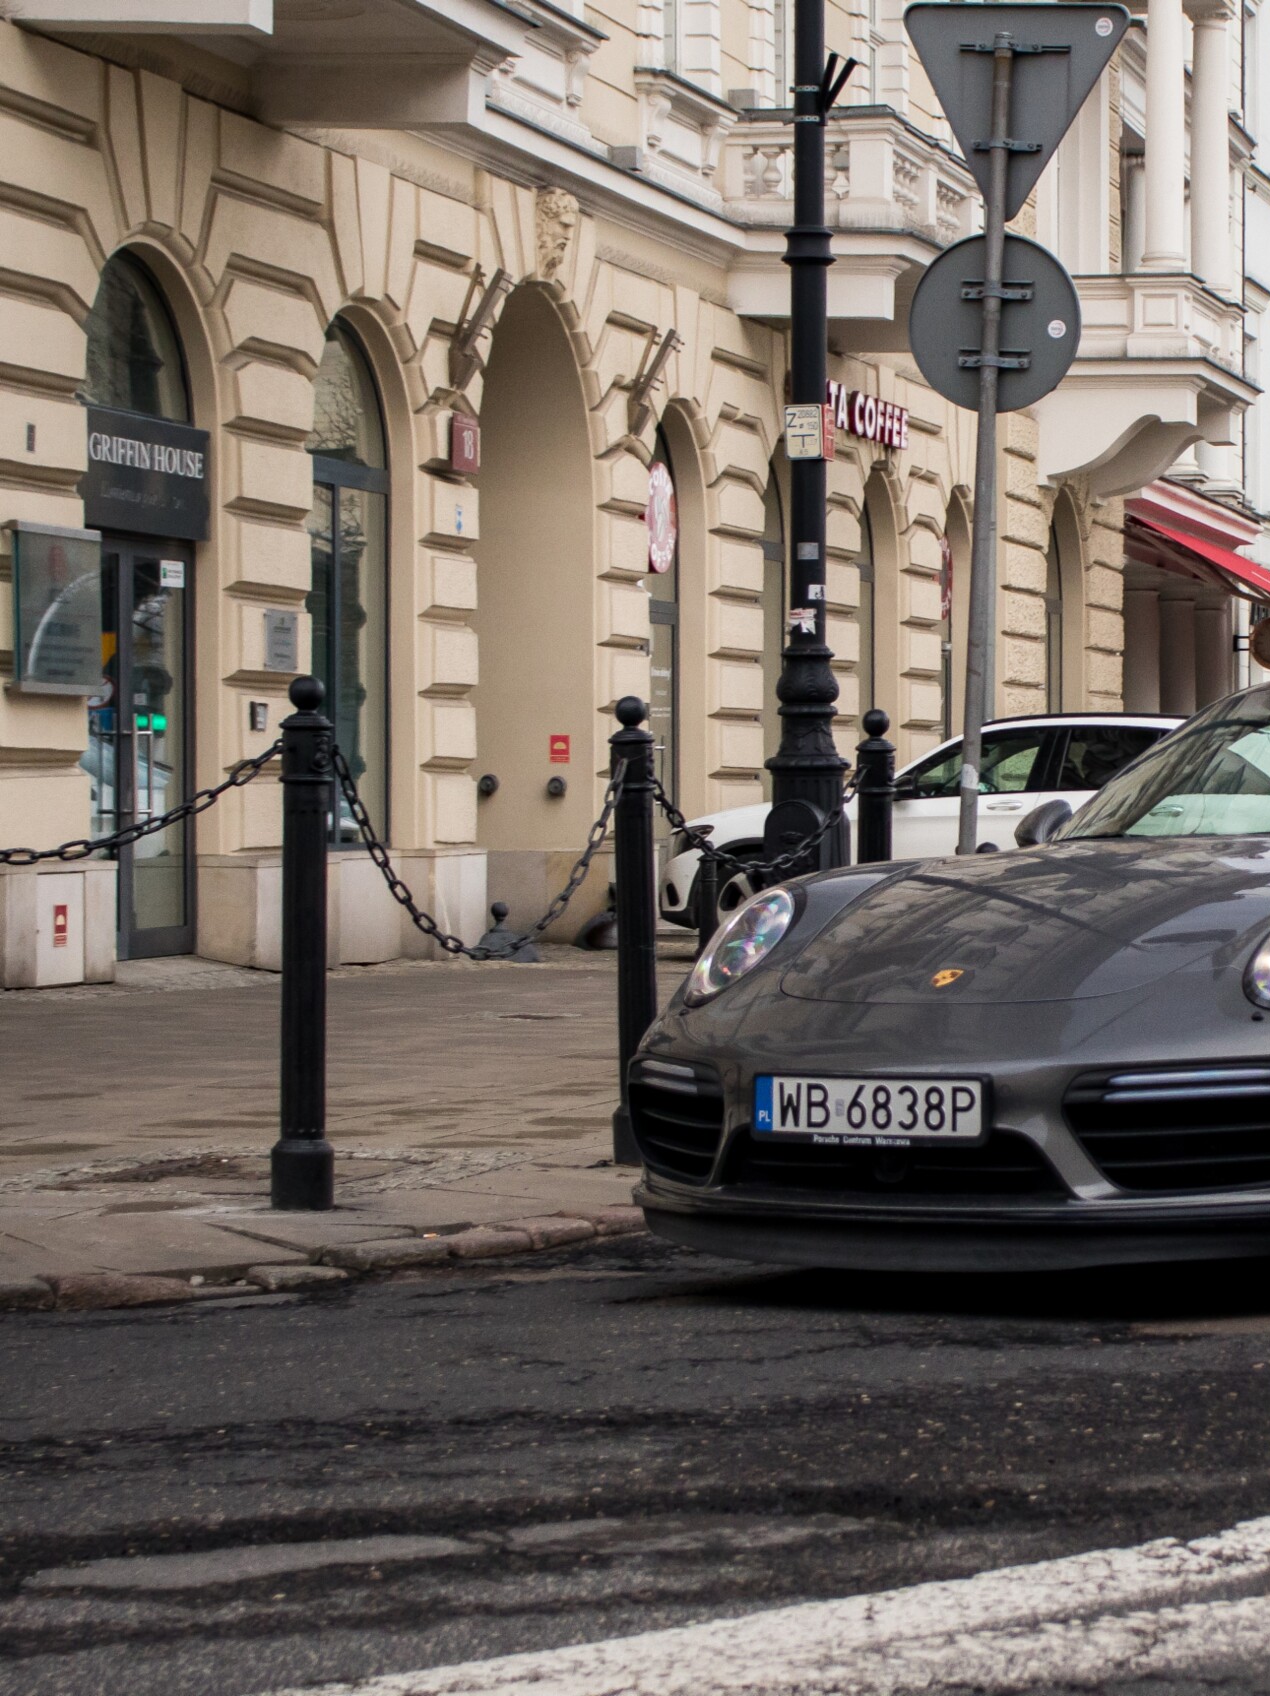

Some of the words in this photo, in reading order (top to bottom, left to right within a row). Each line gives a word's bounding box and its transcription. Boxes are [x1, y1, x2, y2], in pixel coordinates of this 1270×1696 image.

[786, 412, 798, 428] Z
[852, 391, 908, 449] COFFEE
[89, 432, 151, 470] GRIFFIN
[153, 444, 204, 479] HOUSE
[462, 430, 474, 460] 18
[758, 1110, 771, 1123] PL
[779, 1081, 831, 1129] WB
[846, 1083, 977, 1133] 6838P
